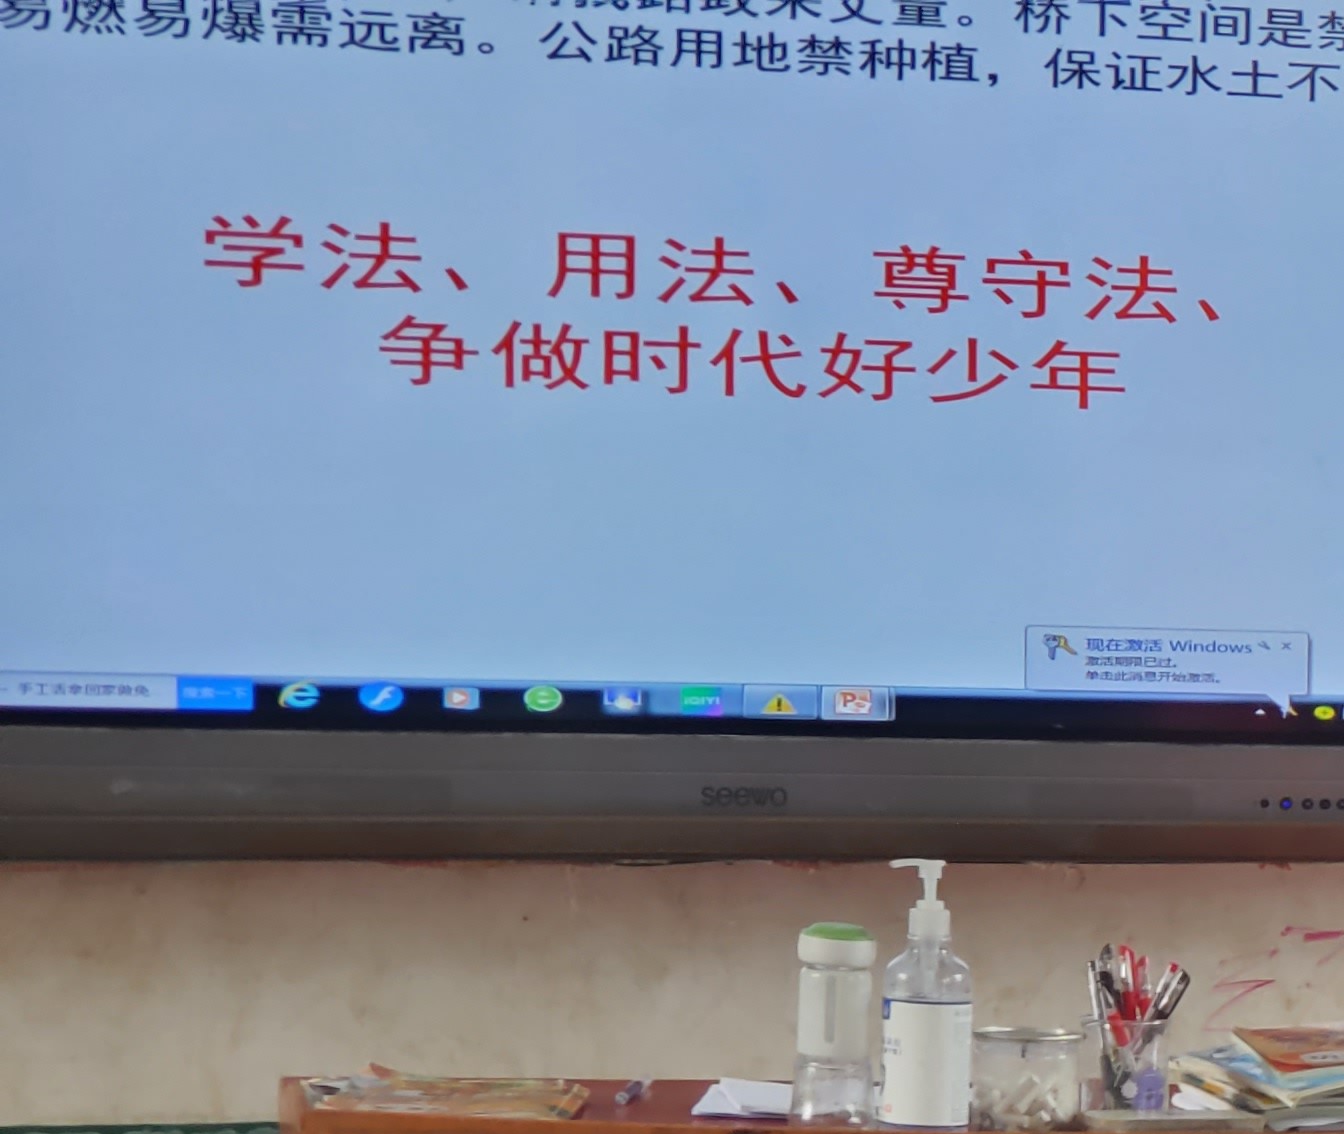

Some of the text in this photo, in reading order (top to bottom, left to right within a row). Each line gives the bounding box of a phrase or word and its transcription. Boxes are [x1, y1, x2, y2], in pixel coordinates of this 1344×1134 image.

[379, 314, 1125, 410] 争做时代好少年
[1085, 638, 1253, 654] 现在激活 Windows
[701, 786, 788, 808] seewo
